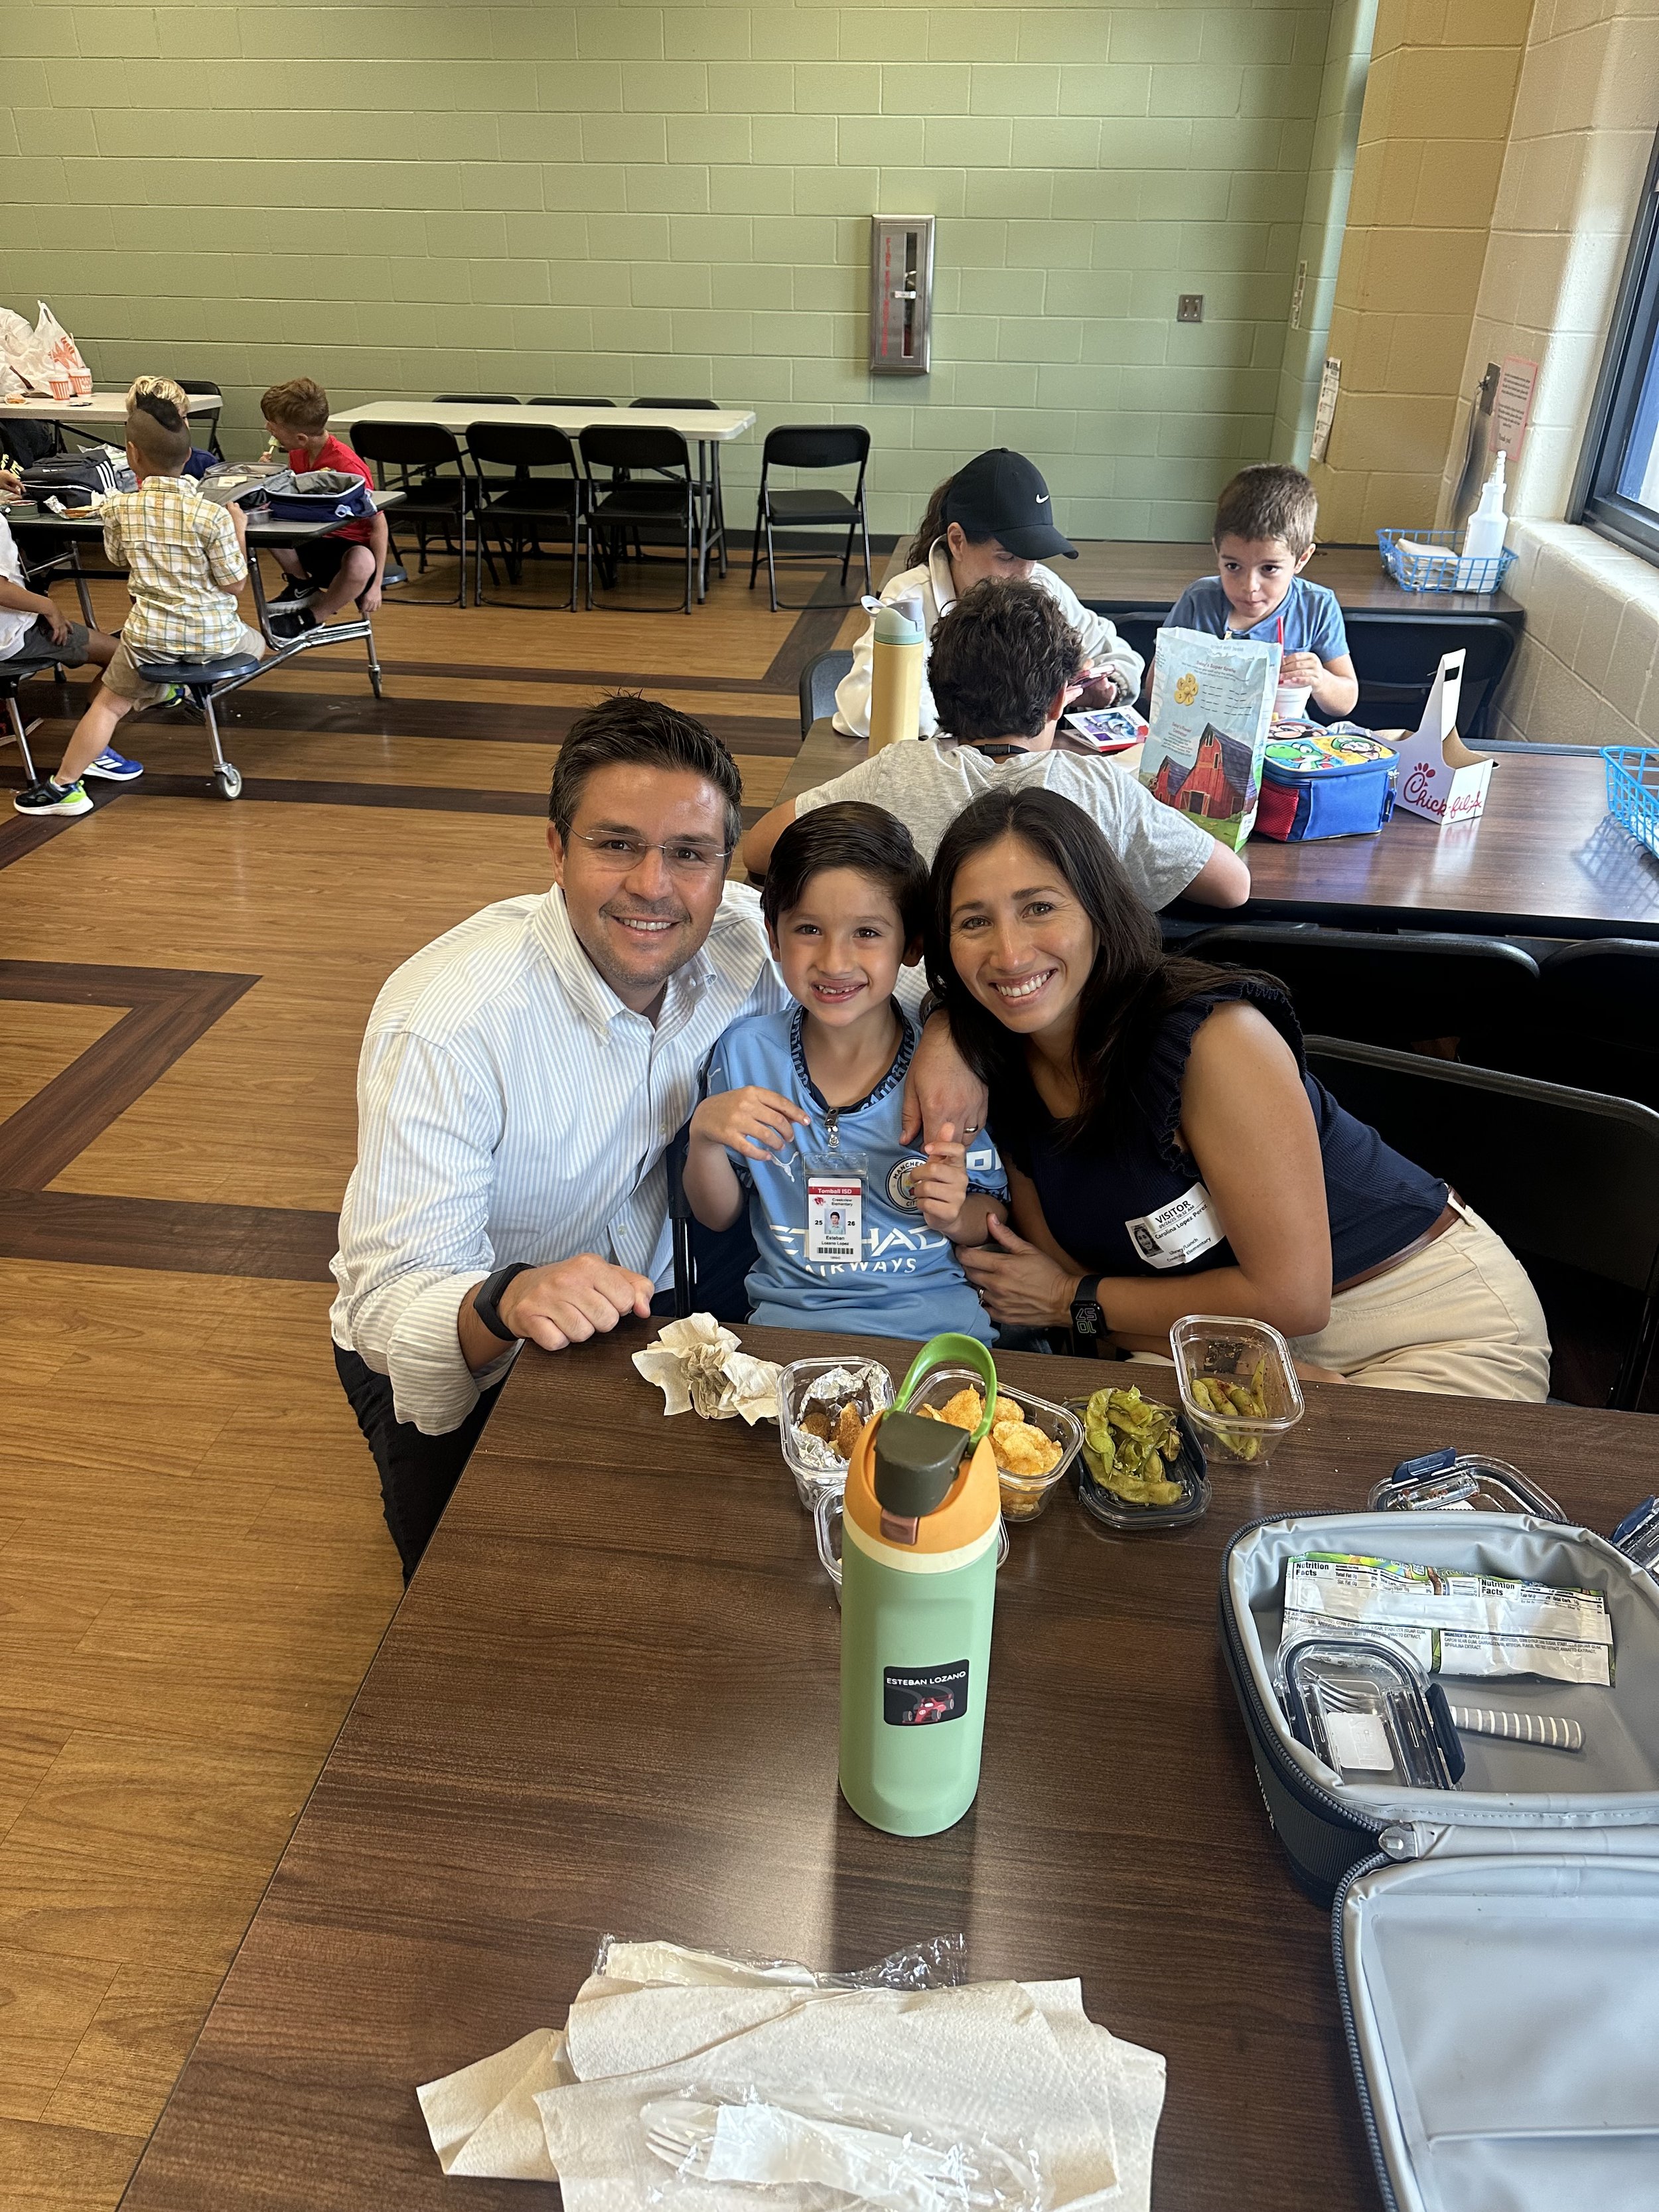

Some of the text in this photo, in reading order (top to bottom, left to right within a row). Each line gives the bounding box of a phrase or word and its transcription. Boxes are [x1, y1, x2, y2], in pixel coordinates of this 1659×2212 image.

[1403, 770, 1482, 819] Chick-fil-A
[893, 1161, 924, 1179] MANCHE
[1155, 1200, 1192, 1224] VISITOR
[1155, 1204, 1208, 1240] Carolina Lopez Perez
[769, 1224, 950, 1256] ETHAD
[1186, 1236, 1212, 1256] Elementary
[1076, 1307, 1097, 1321] 57
[1076, 1321, 1096, 1334] 10
[1295, 1562, 1329, 1570] Nutrition
[1481, 1578, 1515, 1590] Nutrition
[1481, 1586, 1504, 1597] Facts
[887, 1670, 966, 1686] ESTEBAN LOZANO
